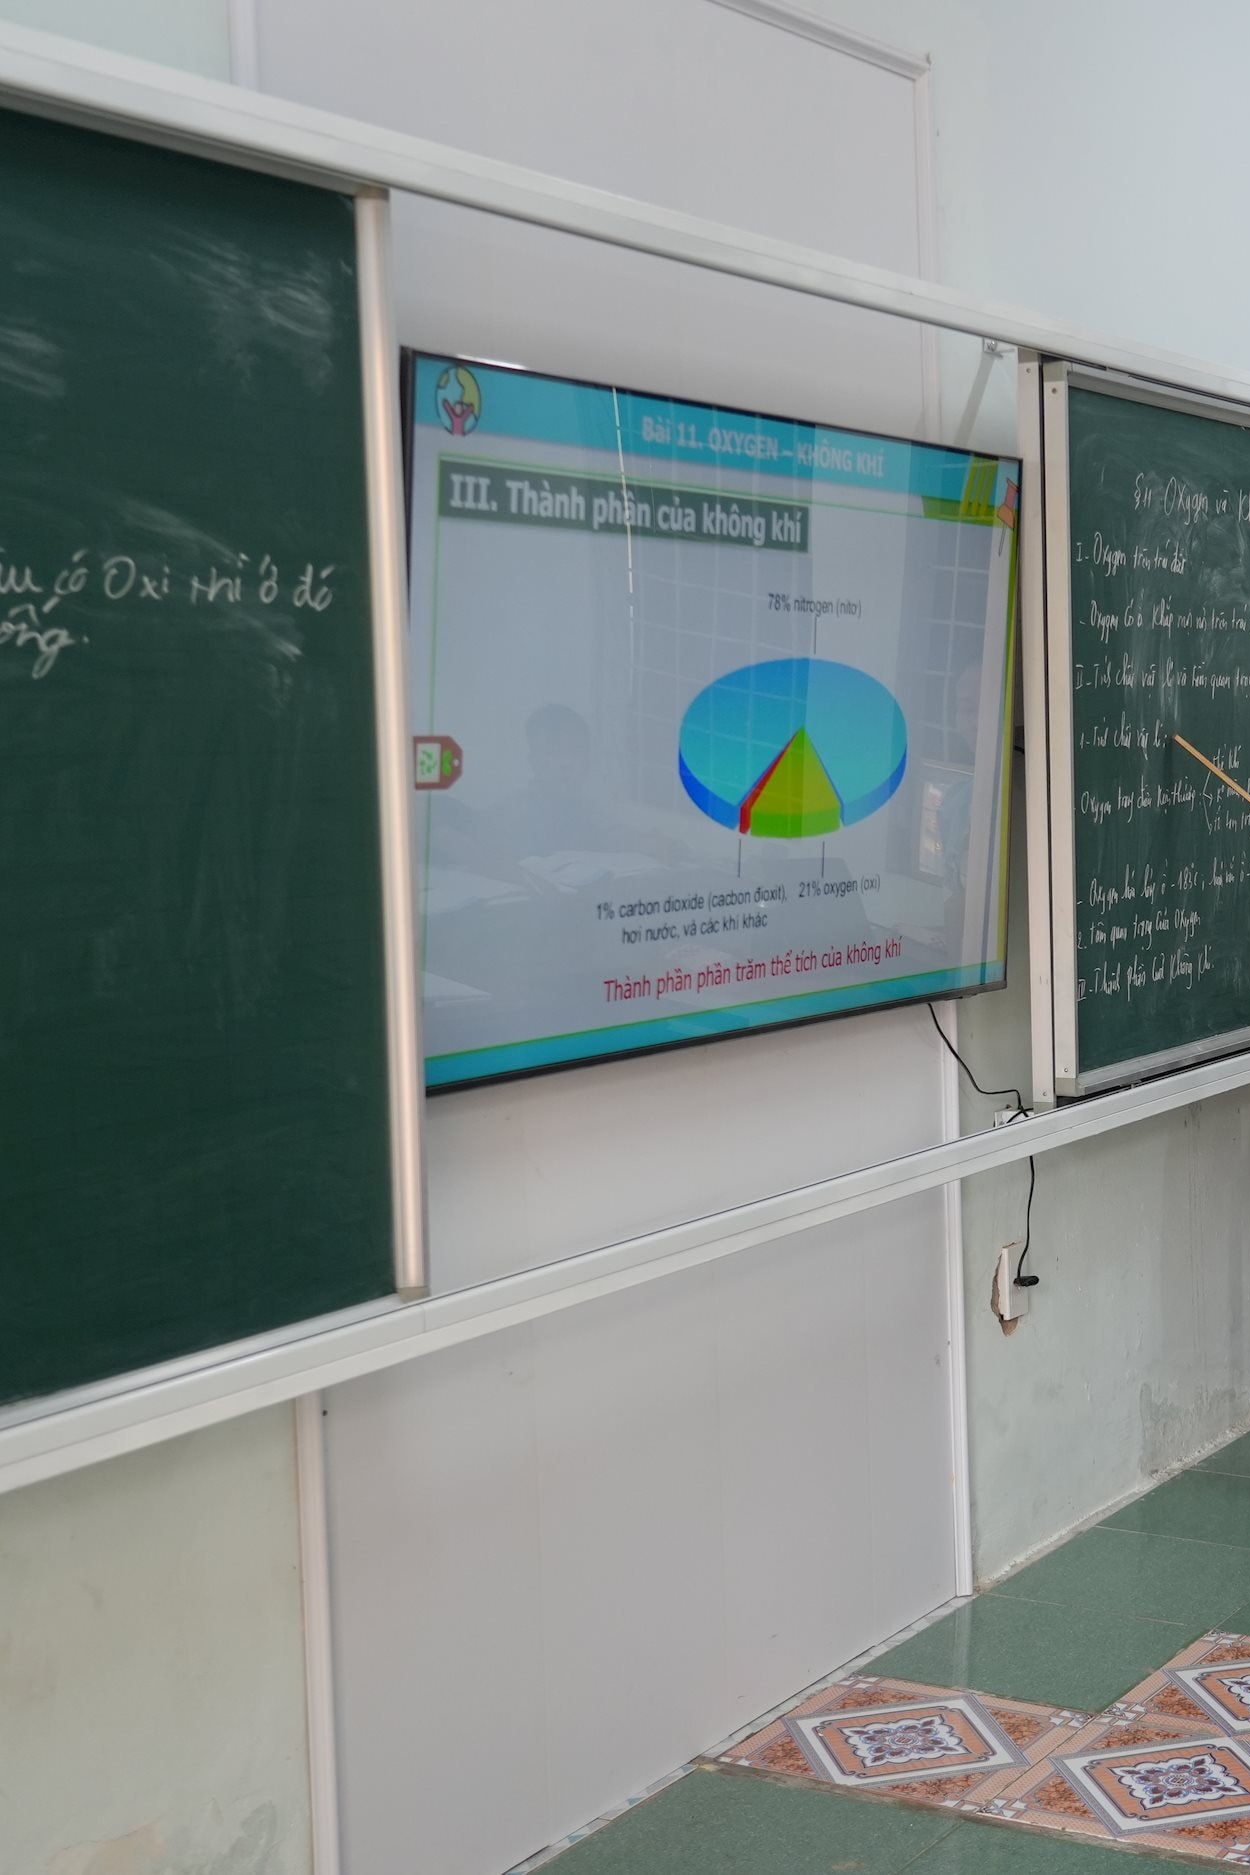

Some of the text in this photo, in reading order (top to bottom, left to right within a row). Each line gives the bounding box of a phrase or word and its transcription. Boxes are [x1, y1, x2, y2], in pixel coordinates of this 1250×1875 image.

[641, 416, 671, 443] Bài
[677, 421, 703, 449] 11.
[708, 428, 778, 461] OXYGEN
[797, 438, 852, 473] KHÔNG
[856, 447, 885, 477] KHÍ
[450, 473, 803, 546] III. Thành phần của không khí
[294, 562, 336, 612] đó
[768, 593, 791, 612] 78%
[793, 597, 833, 617] nitrogen
[597, 902, 615, 920] 1%
[619, 900, 660, 918] carbon
[664, 893, 705, 912] dioxide
[708, 891, 750, 912] (cacbon
[798, 874, 880, 898] 21% oxygen (oxi)
[622, 911, 768, 944] hơi nước, và các khí khác
[604, 936, 903, 1002] Thành phần phần trăm thể tích của không khí
